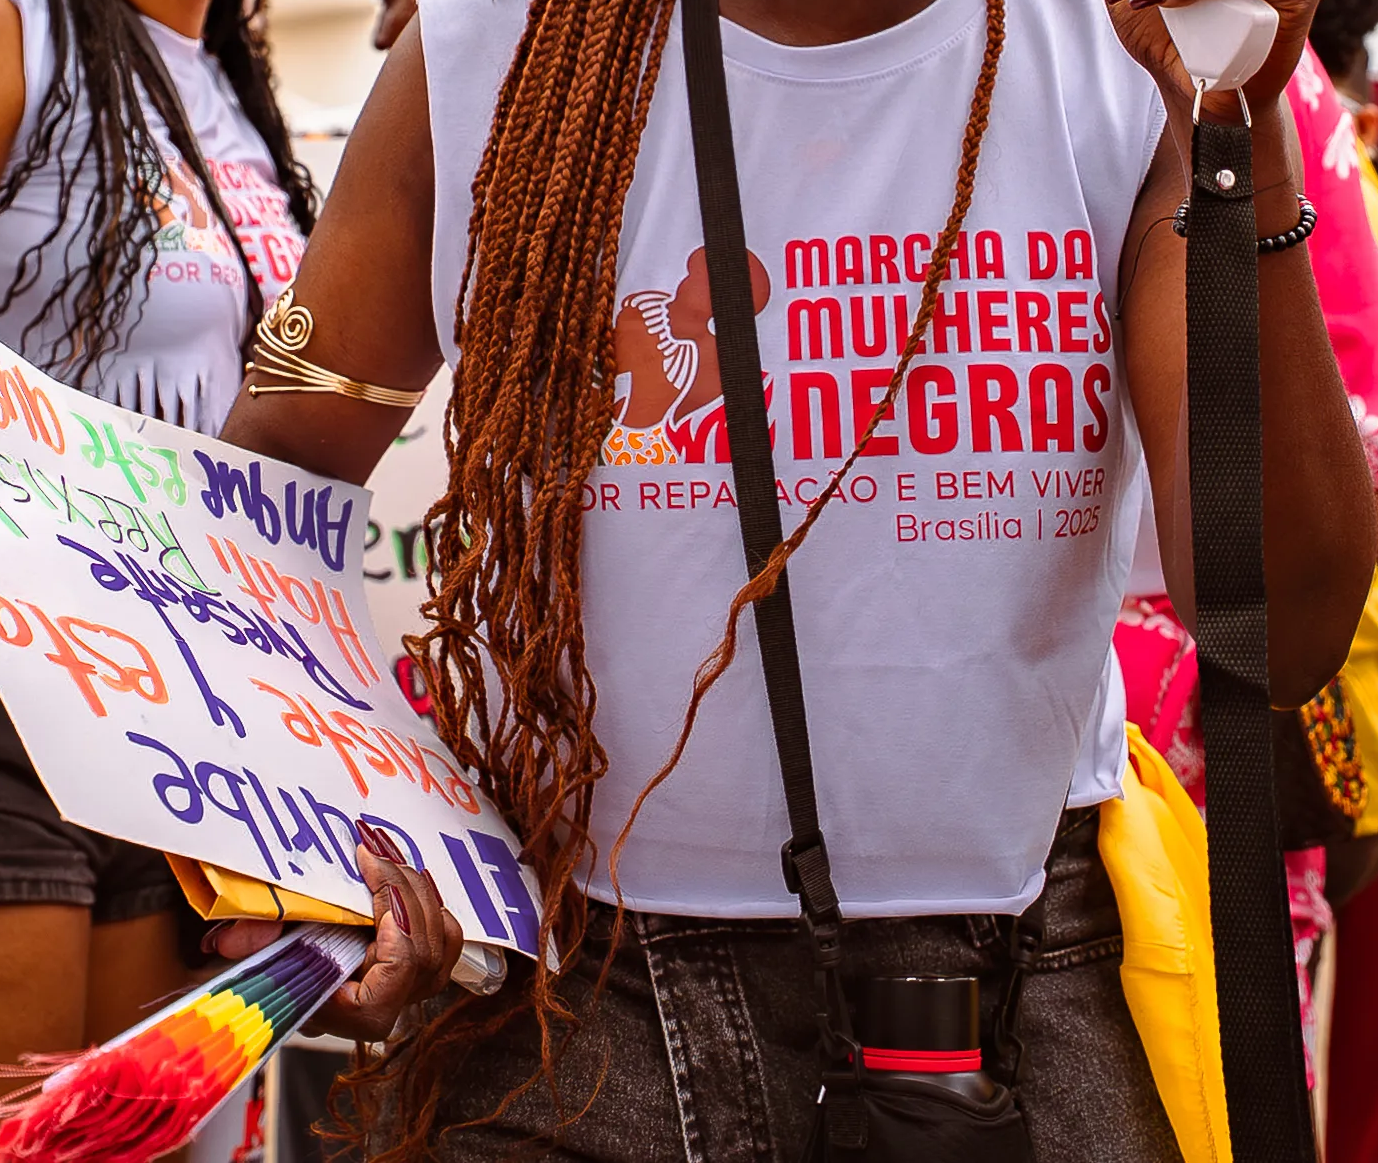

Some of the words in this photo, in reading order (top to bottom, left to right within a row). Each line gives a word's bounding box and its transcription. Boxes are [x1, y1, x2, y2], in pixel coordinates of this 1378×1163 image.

[784, 229, 1005, 289] MARCHA
[1027, 228, 1094, 280] DA
[786, 290, 1113, 361] MULHERES
[789, 363, 1112, 461] NEGRAS
[581, 483, 622, 511] OR
[638, 469, 879, 512] REPAAÇÃO
[896, 473, 917, 501] E
[935, 470, 1016, 501] BEM
[1031, 467, 1106, 499] VIVER
[896, 511, 1023, 543] Brasília
[1053, 505, 1102, 539] 2025
[247, 677, 482, 816] existe
